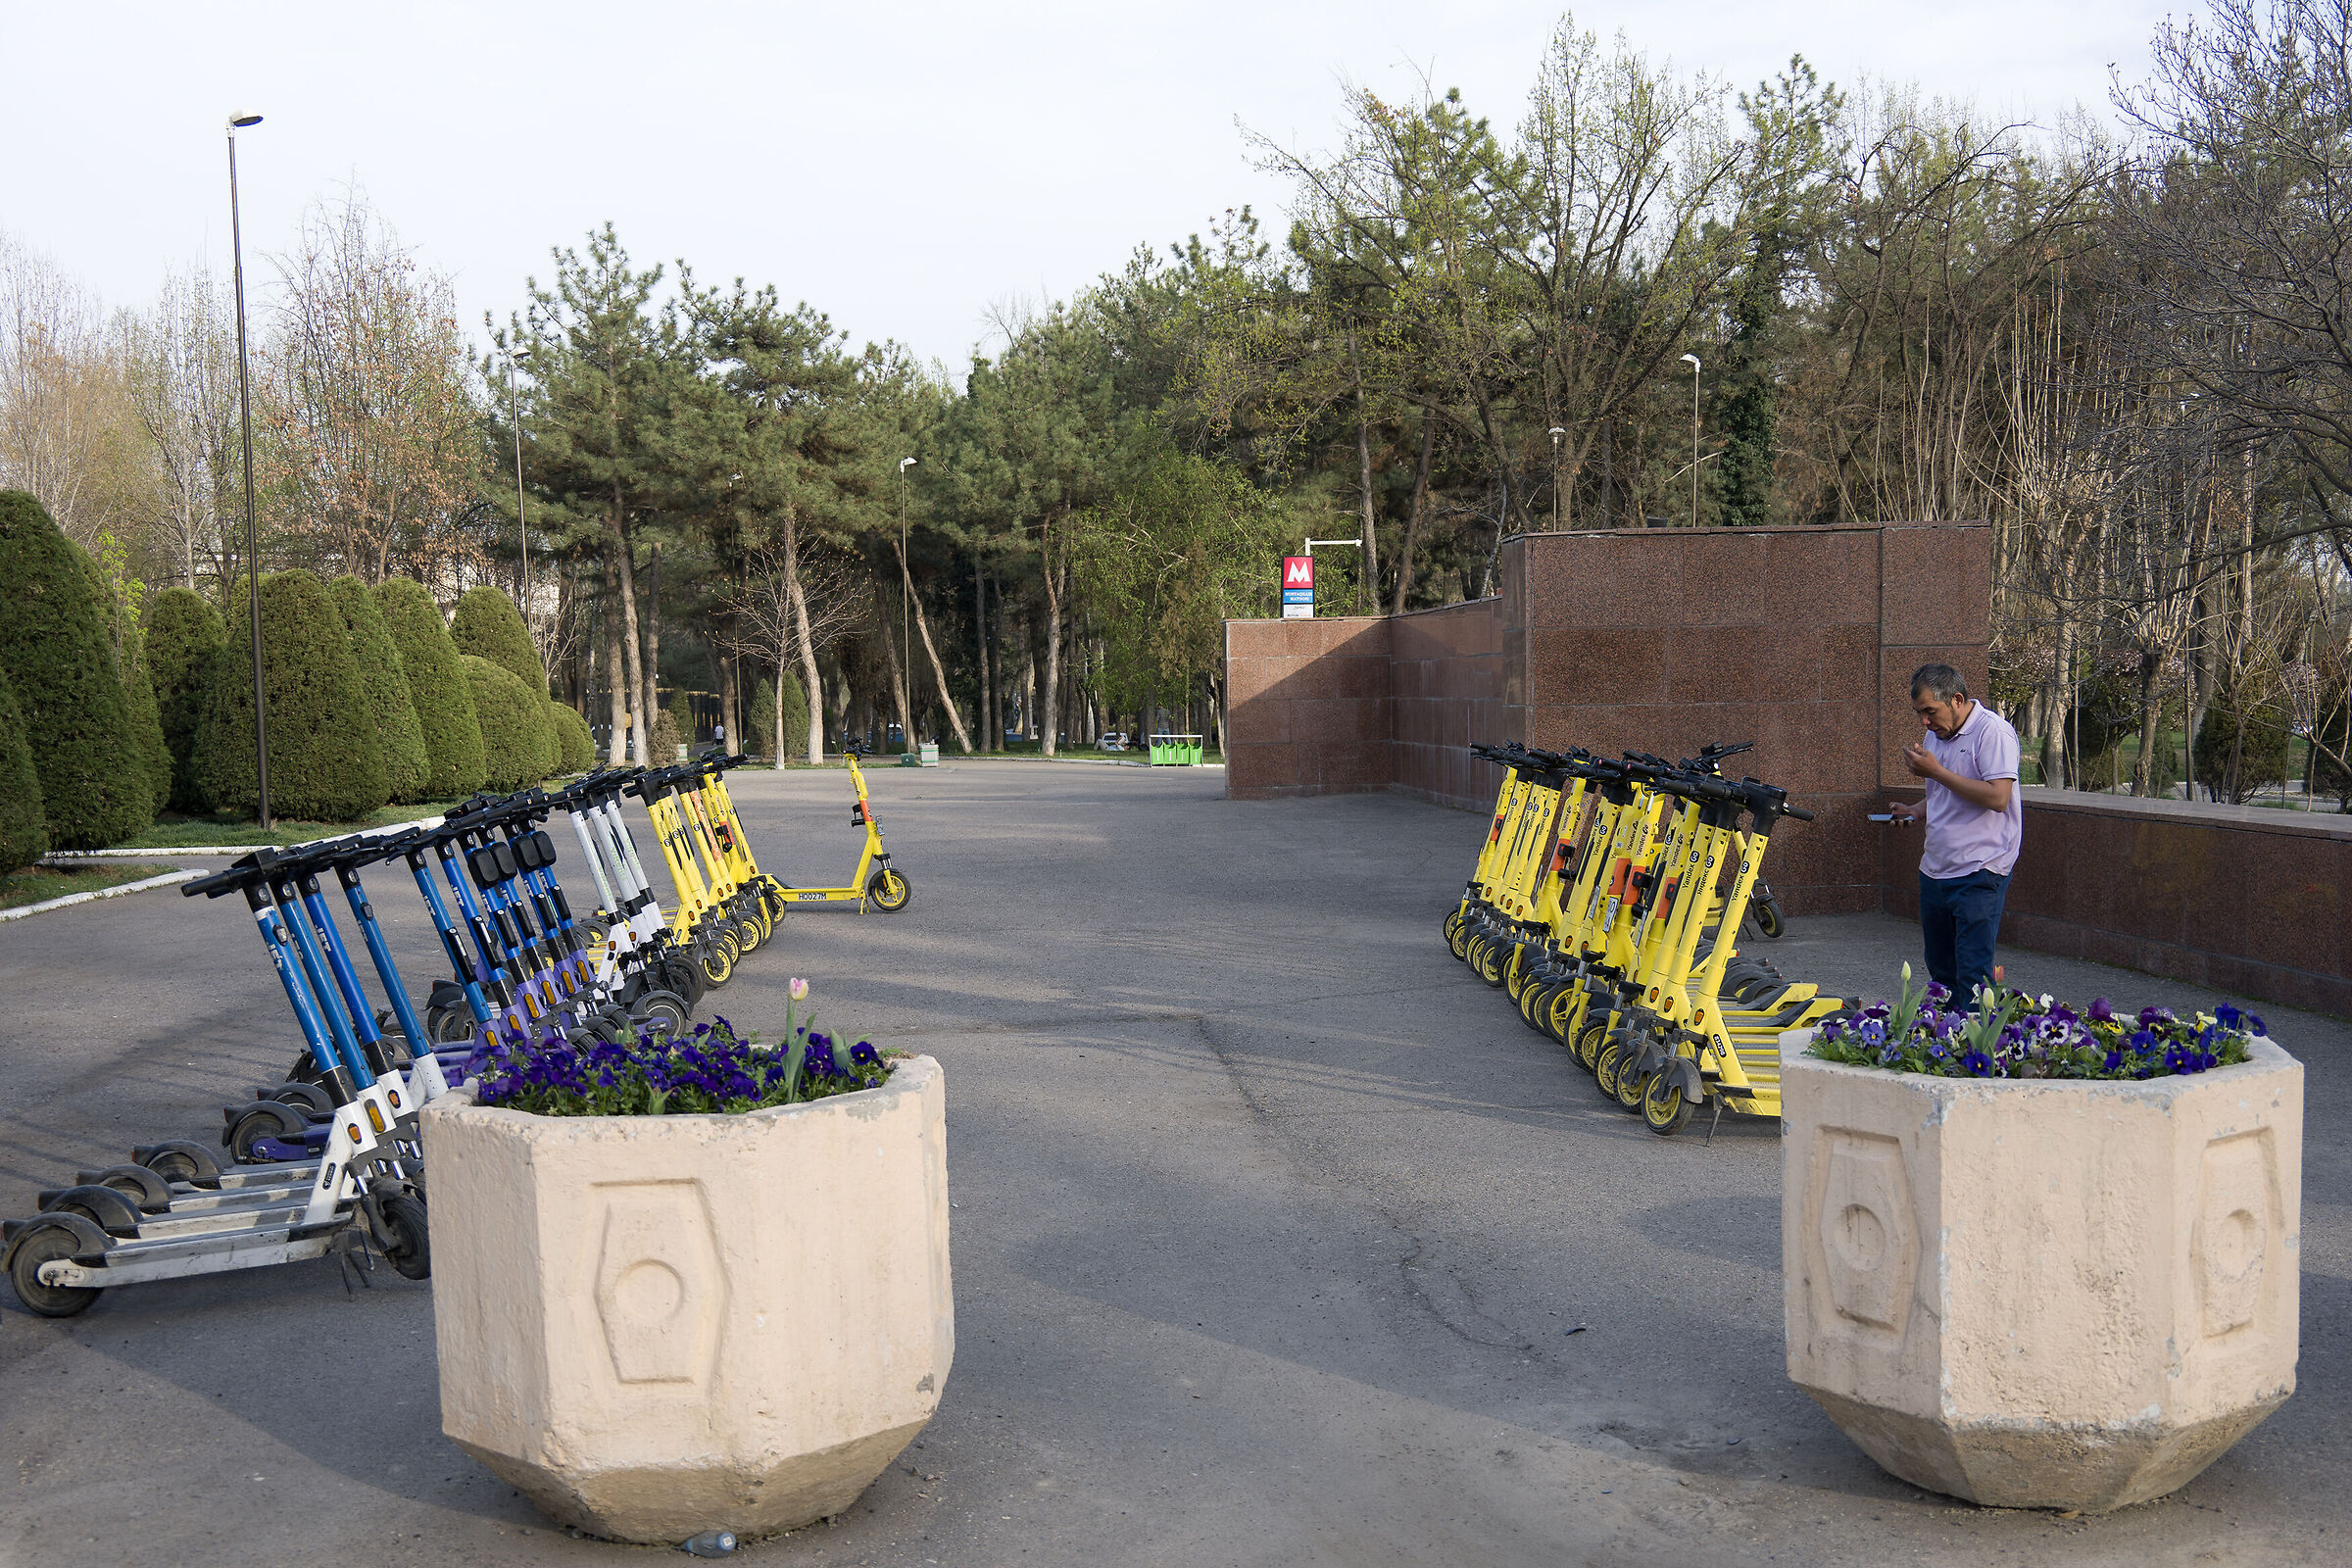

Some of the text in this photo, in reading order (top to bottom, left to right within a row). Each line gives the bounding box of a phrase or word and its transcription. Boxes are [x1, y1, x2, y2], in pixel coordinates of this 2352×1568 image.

[1287, 561, 1311, 583] M
[1636, 833, 1647, 856] Yandex
[1671, 845, 1682, 867] Yandex
[1682, 863, 1695, 889] Yandex
[1696, 869, 1710, 896] Яндекс
[1732, 874, 1744, 902] Yandex
[452, 884, 466, 906] JET
[315, 924, 332, 952] JET
